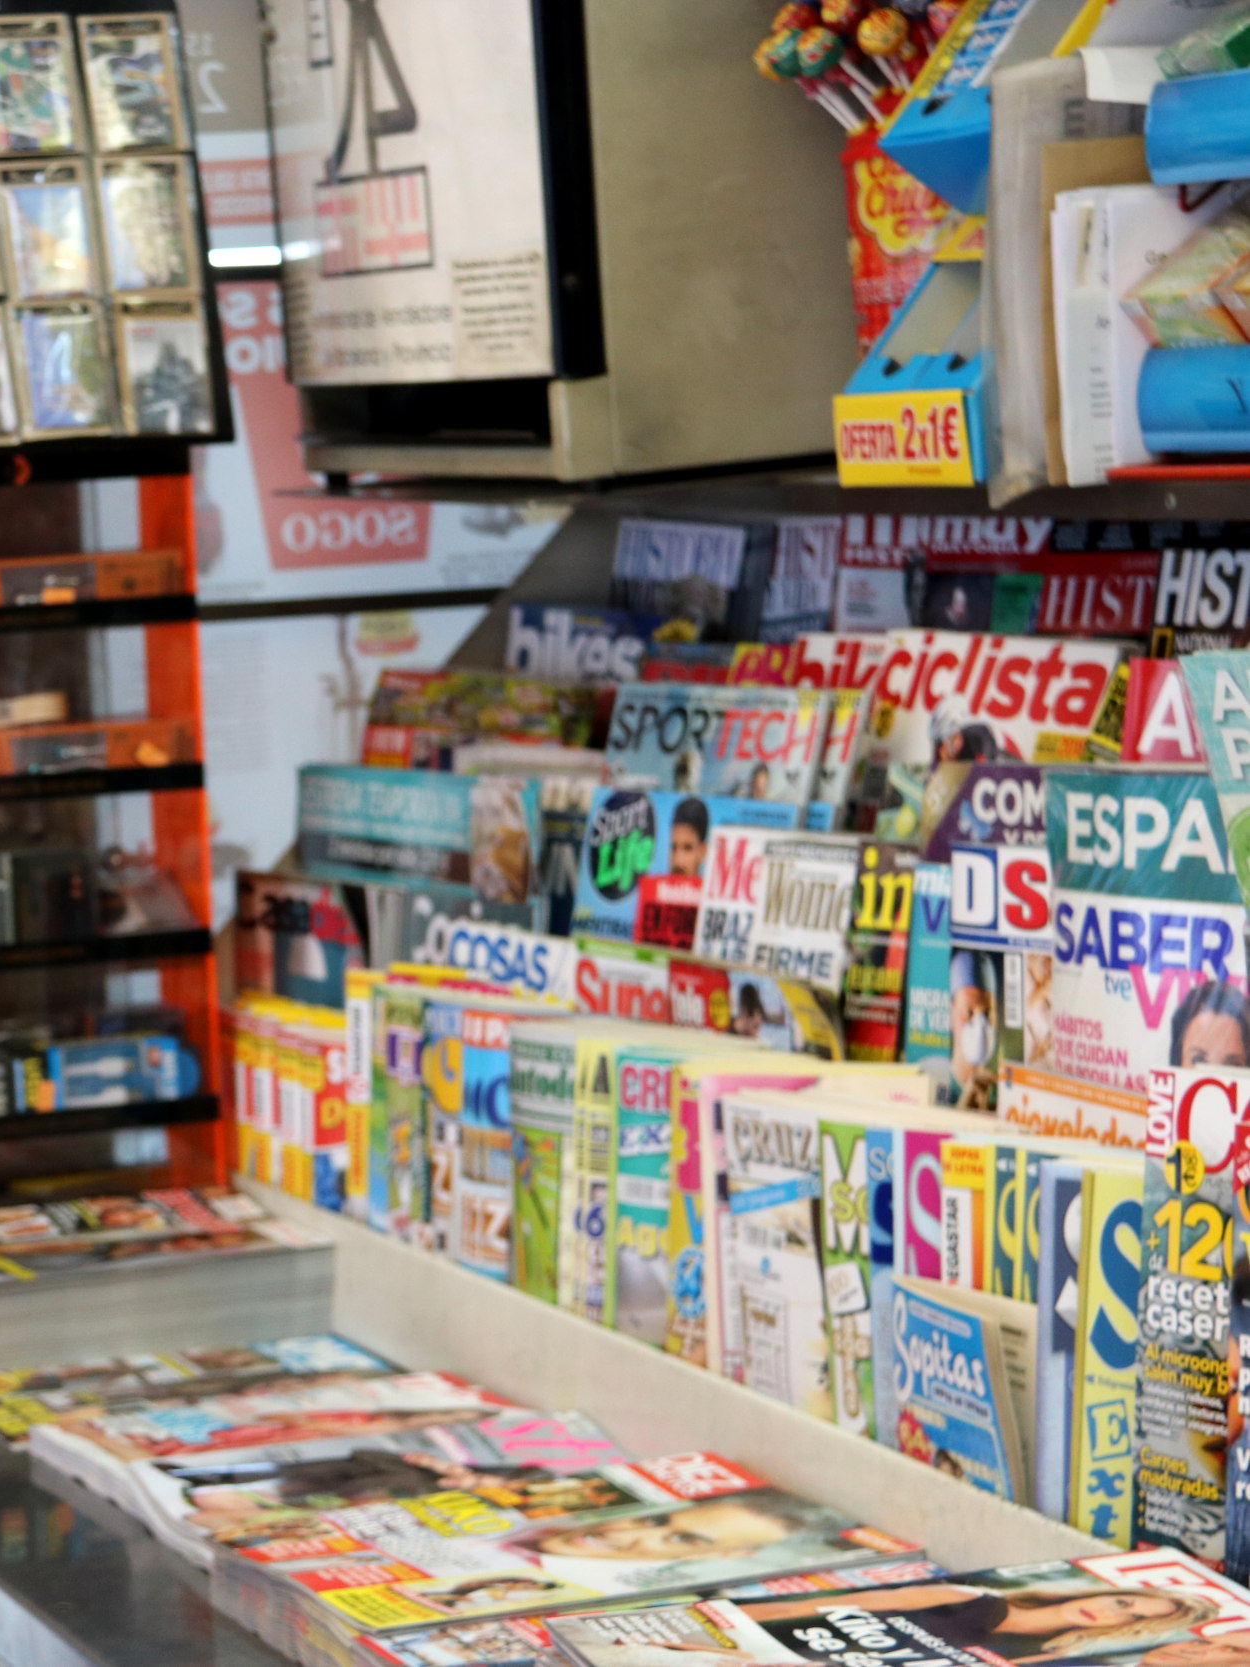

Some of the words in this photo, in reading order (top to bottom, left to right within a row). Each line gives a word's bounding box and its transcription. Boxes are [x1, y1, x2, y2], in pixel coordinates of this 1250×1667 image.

[840, 422, 898, 460] OFERTA
[900, 404, 960, 462] 2x1€
[871, 630, 1108, 728] ciclista
[450, 931, 548, 991] COSAS
[754, 945, 835, 979] FIRME
[1054, 901, 1235, 982] SABER
[1077, 1044, 1129, 1068] CUIDAN
[892, 1290, 987, 1403] Sopitas
[1181, 1373, 1216, 1396] muy
[1138, 1468, 1219, 1501] maduradas
[792, 1627, 847, 1652] se
[815, 1605, 898, 1650] Kiko
